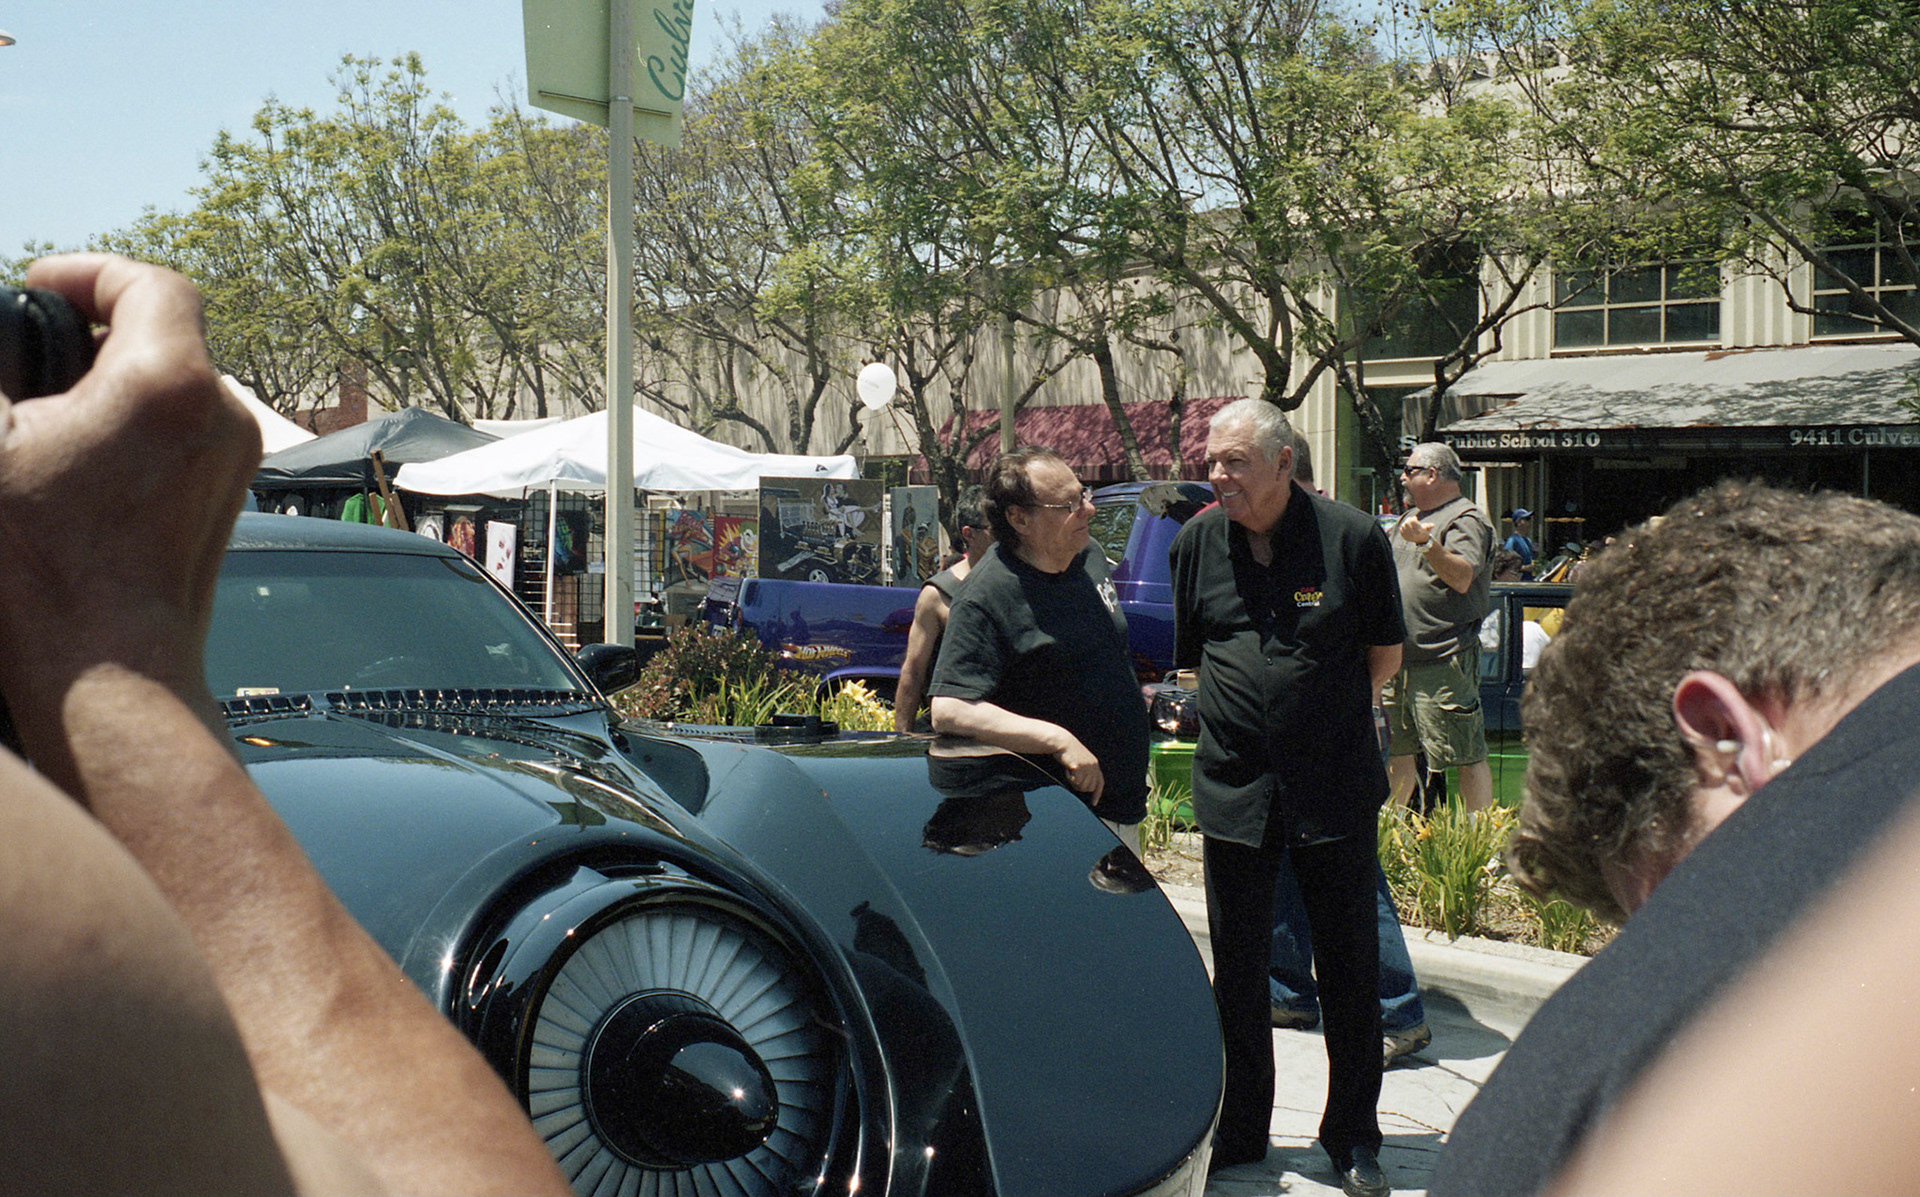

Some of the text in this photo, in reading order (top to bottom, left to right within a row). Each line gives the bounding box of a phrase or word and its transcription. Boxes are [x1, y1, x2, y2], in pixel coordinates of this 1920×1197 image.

[1443, 432, 1600, 449] Public School 310
[1789, 428, 1844, 446] 9411
